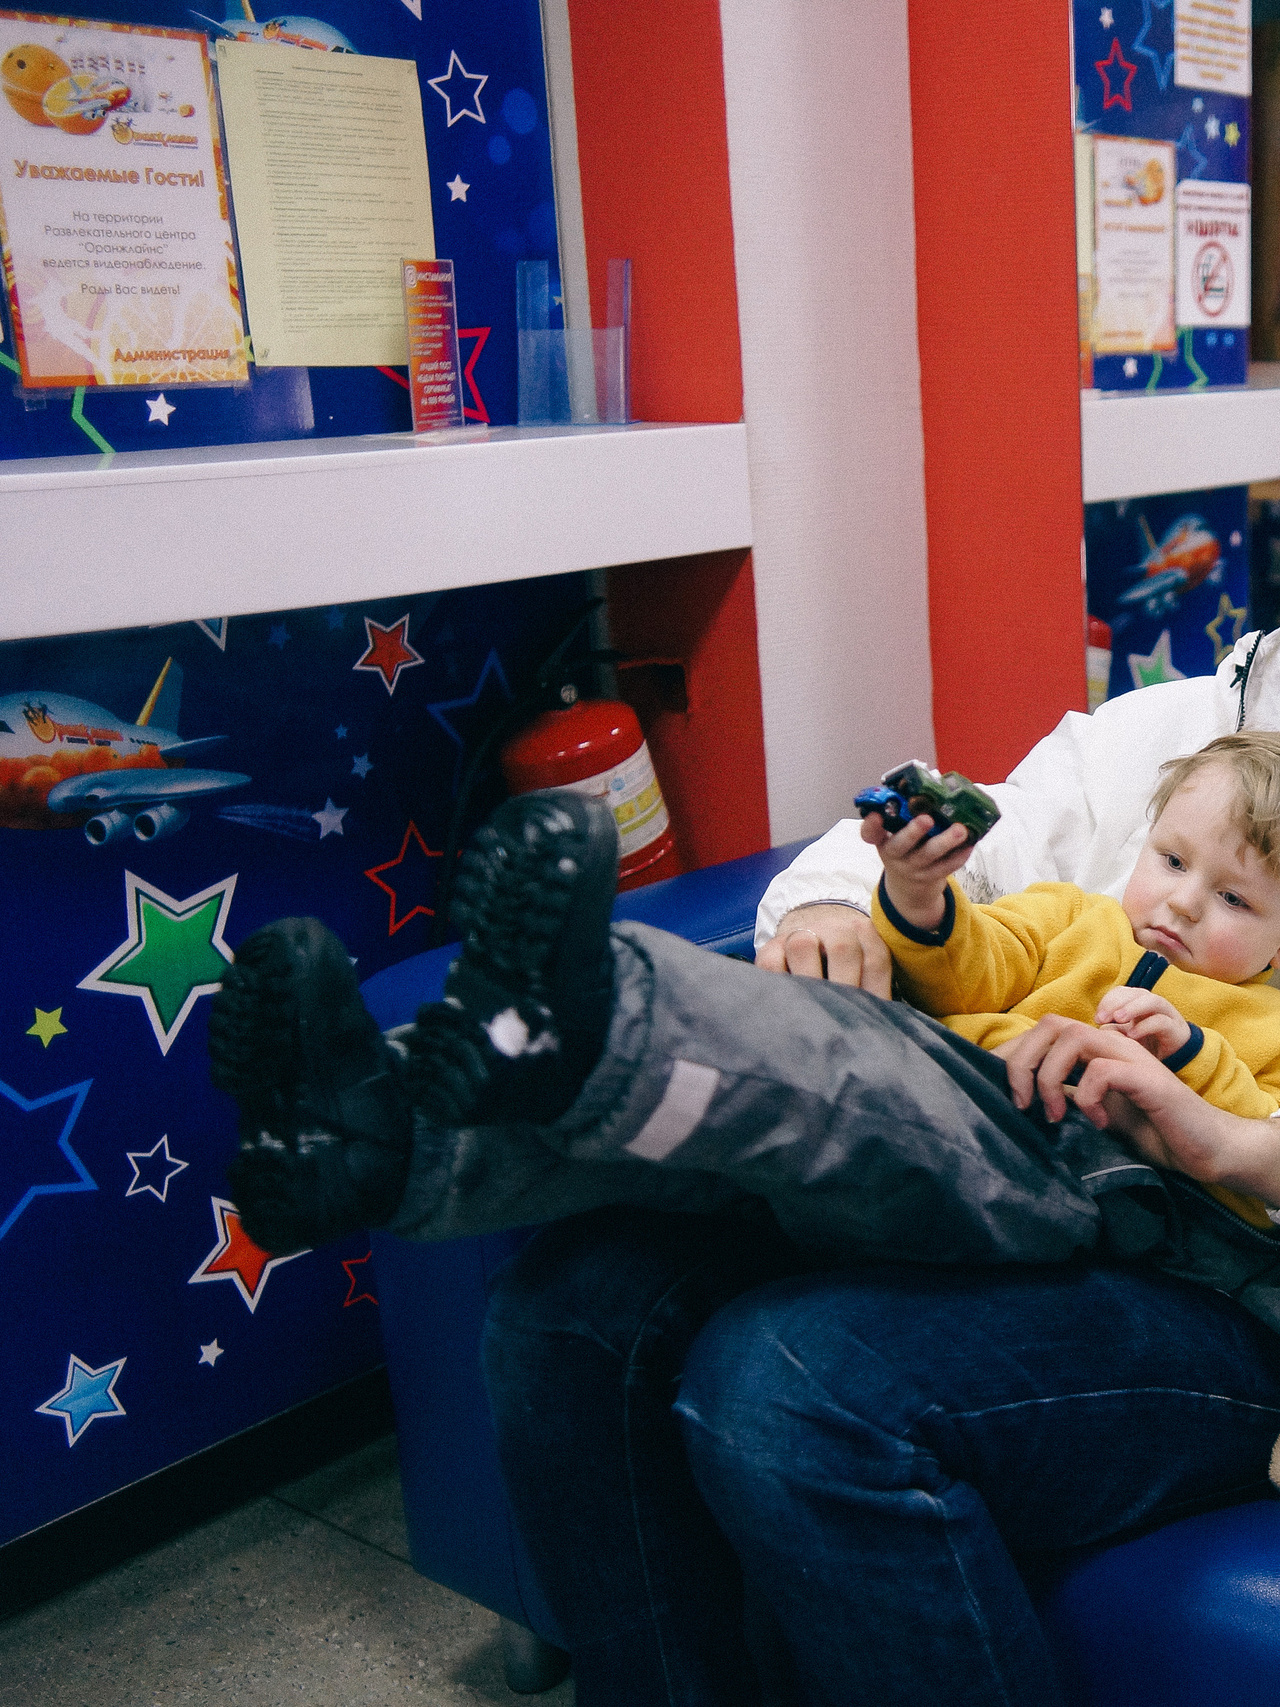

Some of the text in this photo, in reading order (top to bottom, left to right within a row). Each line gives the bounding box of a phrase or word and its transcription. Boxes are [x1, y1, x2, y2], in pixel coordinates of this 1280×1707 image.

[14, 158, 205, 188] Уважаемые Гости!
[72, 210, 164, 225] На территории
[44, 225, 197, 241] Развлекательного центра
[43, 258, 206, 270] ведется видеонаблюдение.
[81, 283, 181, 296] Рады Вас видеть!
[114, 348, 231, 362] Администрация
